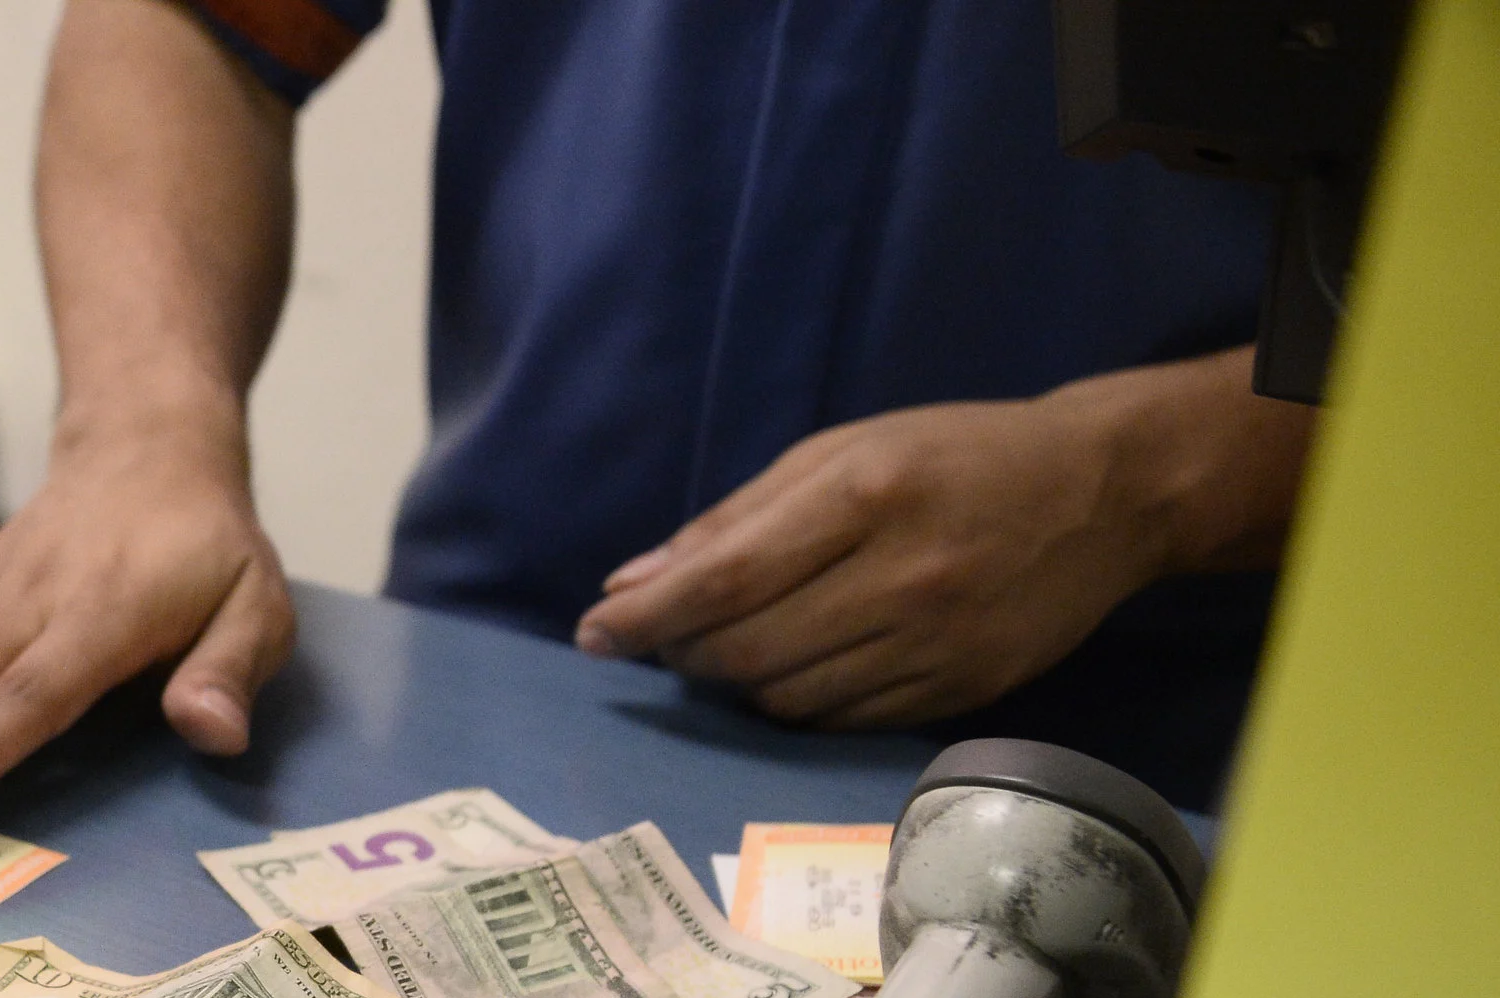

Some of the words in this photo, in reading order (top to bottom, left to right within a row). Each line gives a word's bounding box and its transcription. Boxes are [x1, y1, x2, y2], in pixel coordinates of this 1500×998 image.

[329, 830, 436, 872] 5
[14, 954, 73, 988] 10
[273, 953, 291, 974] WE
